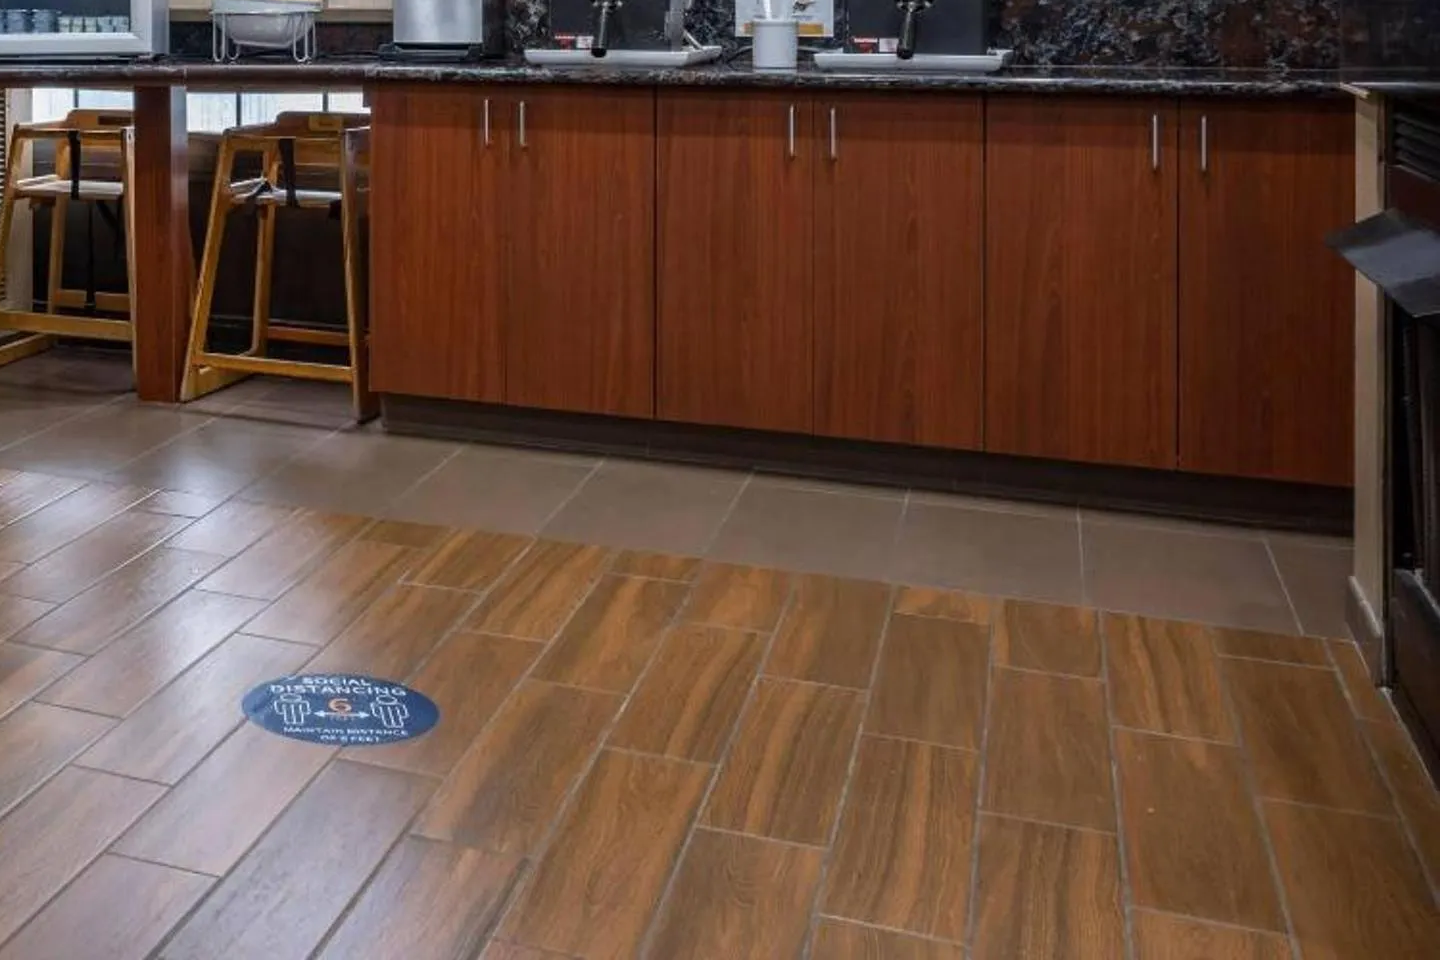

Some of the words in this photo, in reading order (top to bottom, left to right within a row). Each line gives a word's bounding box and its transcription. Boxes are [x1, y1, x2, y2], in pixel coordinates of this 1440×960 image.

[303, 677, 371, 686] SOCIAL
[270, 685, 407, 696] DISTANCING
[328, 698, 352, 713] 6
